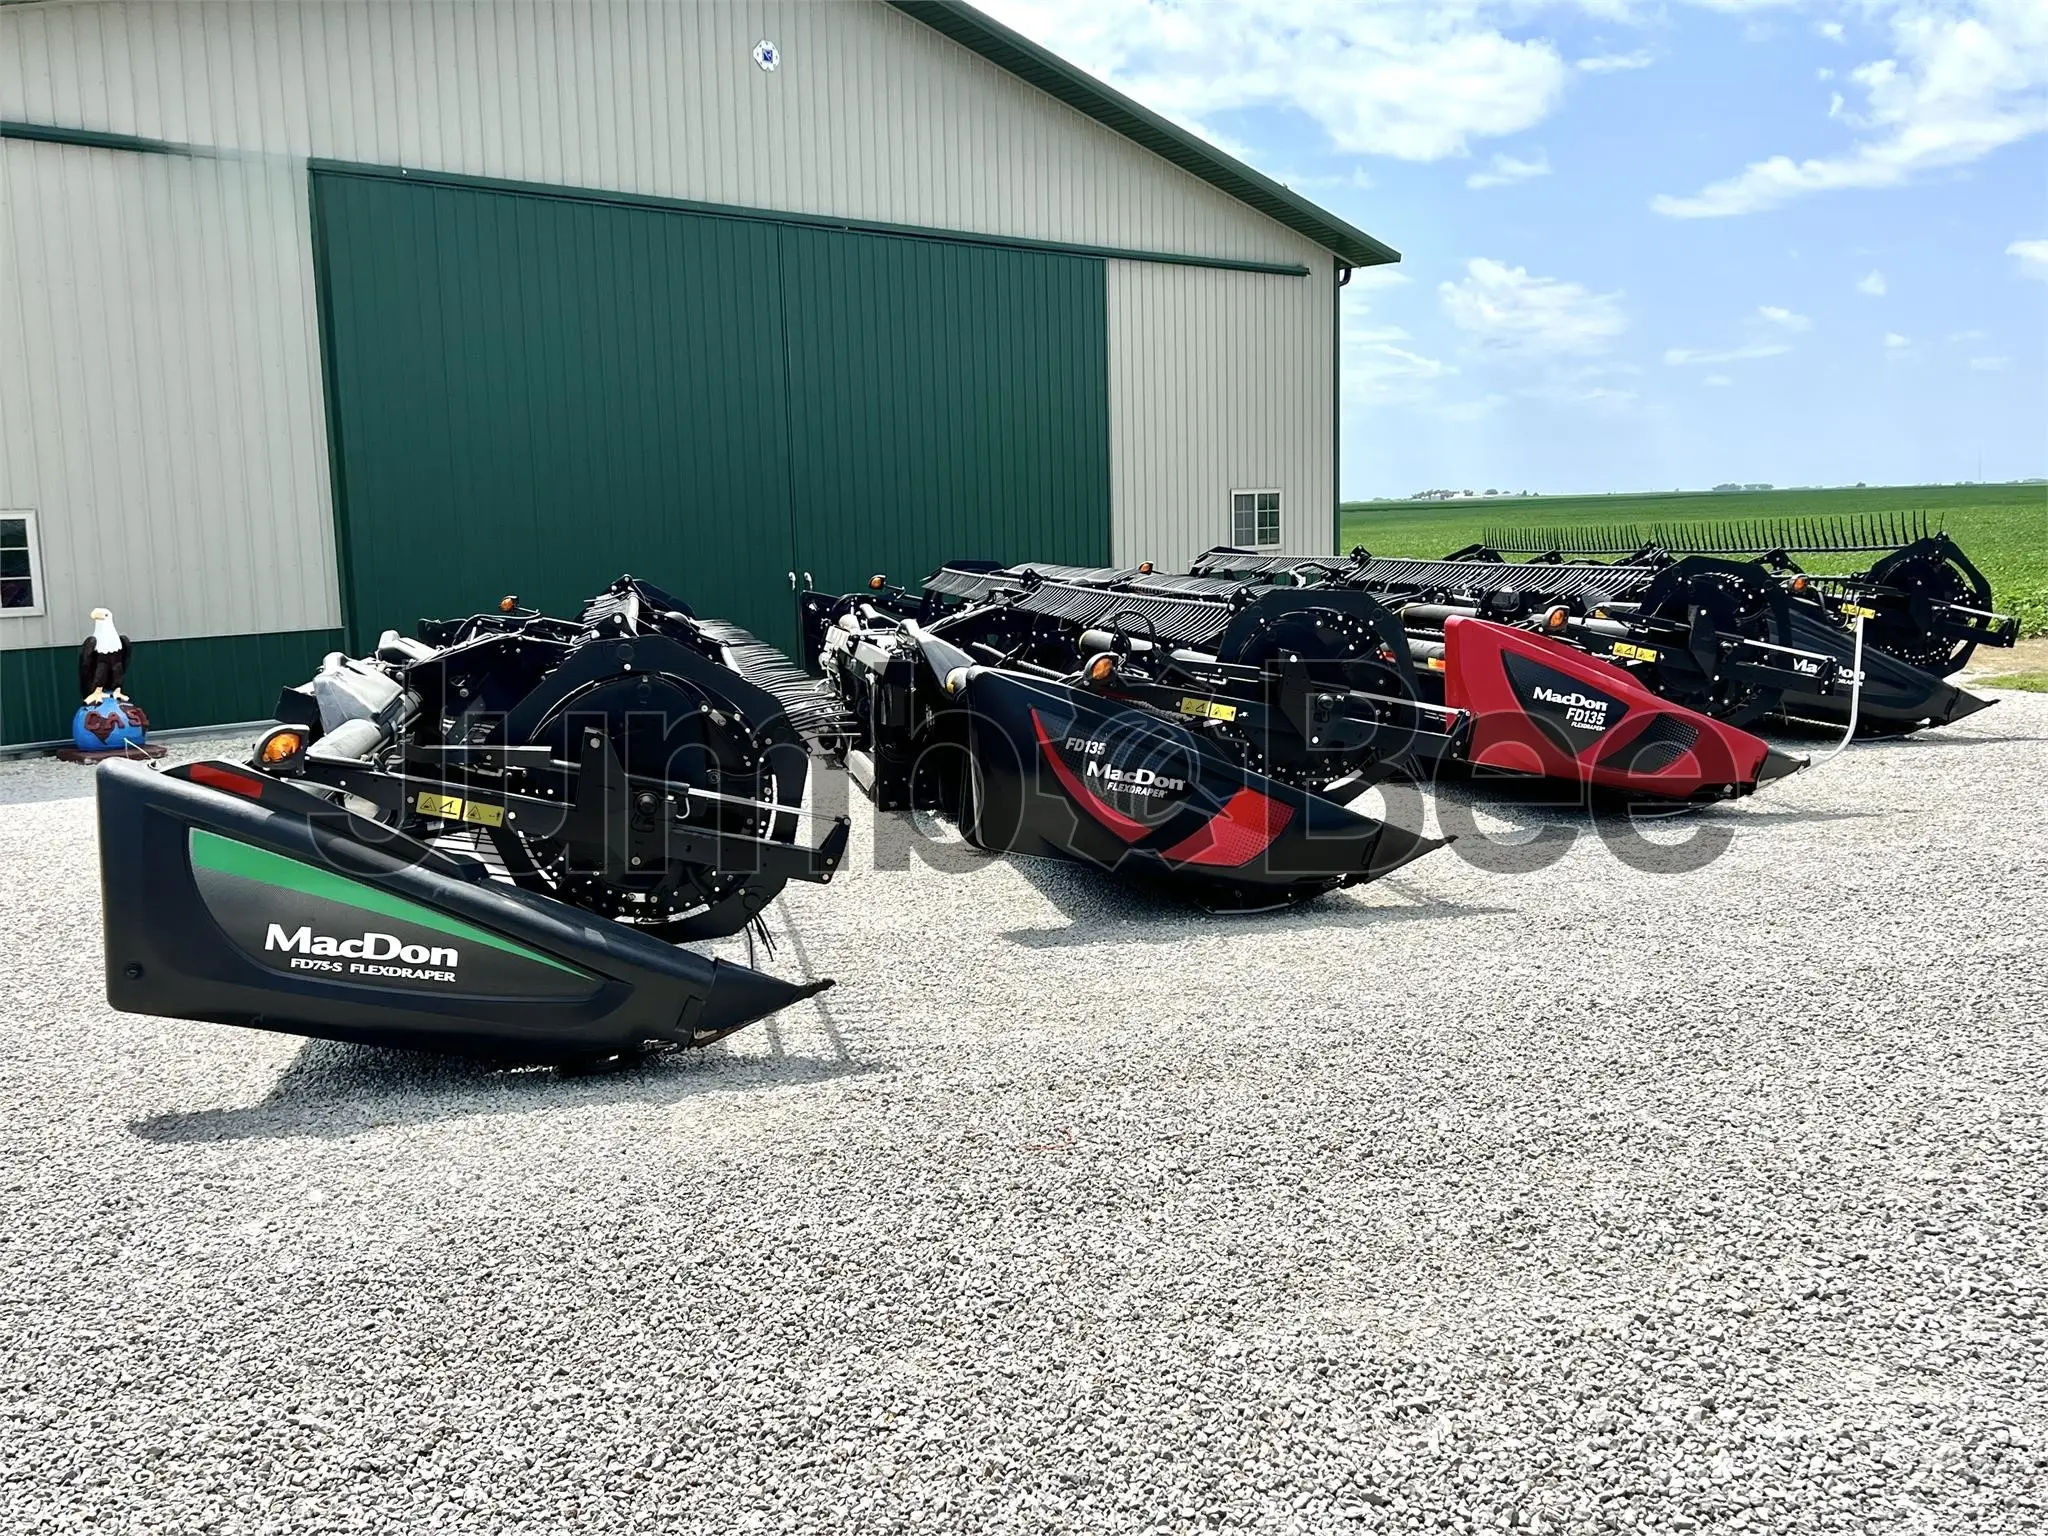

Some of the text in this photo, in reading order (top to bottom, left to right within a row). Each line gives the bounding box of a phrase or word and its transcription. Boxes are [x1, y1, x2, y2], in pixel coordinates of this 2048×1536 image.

[1533, 686, 1608, 711] MacDon
[1565, 707, 1606, 725] FD135
[1065, 737, 1107, 756] FD135
[1086, 761, 1184, 791] MacDon
[264, 923, 459, 967] MacDon
[291, 957, 456, 982] FD75-S FLEXDRAPER
